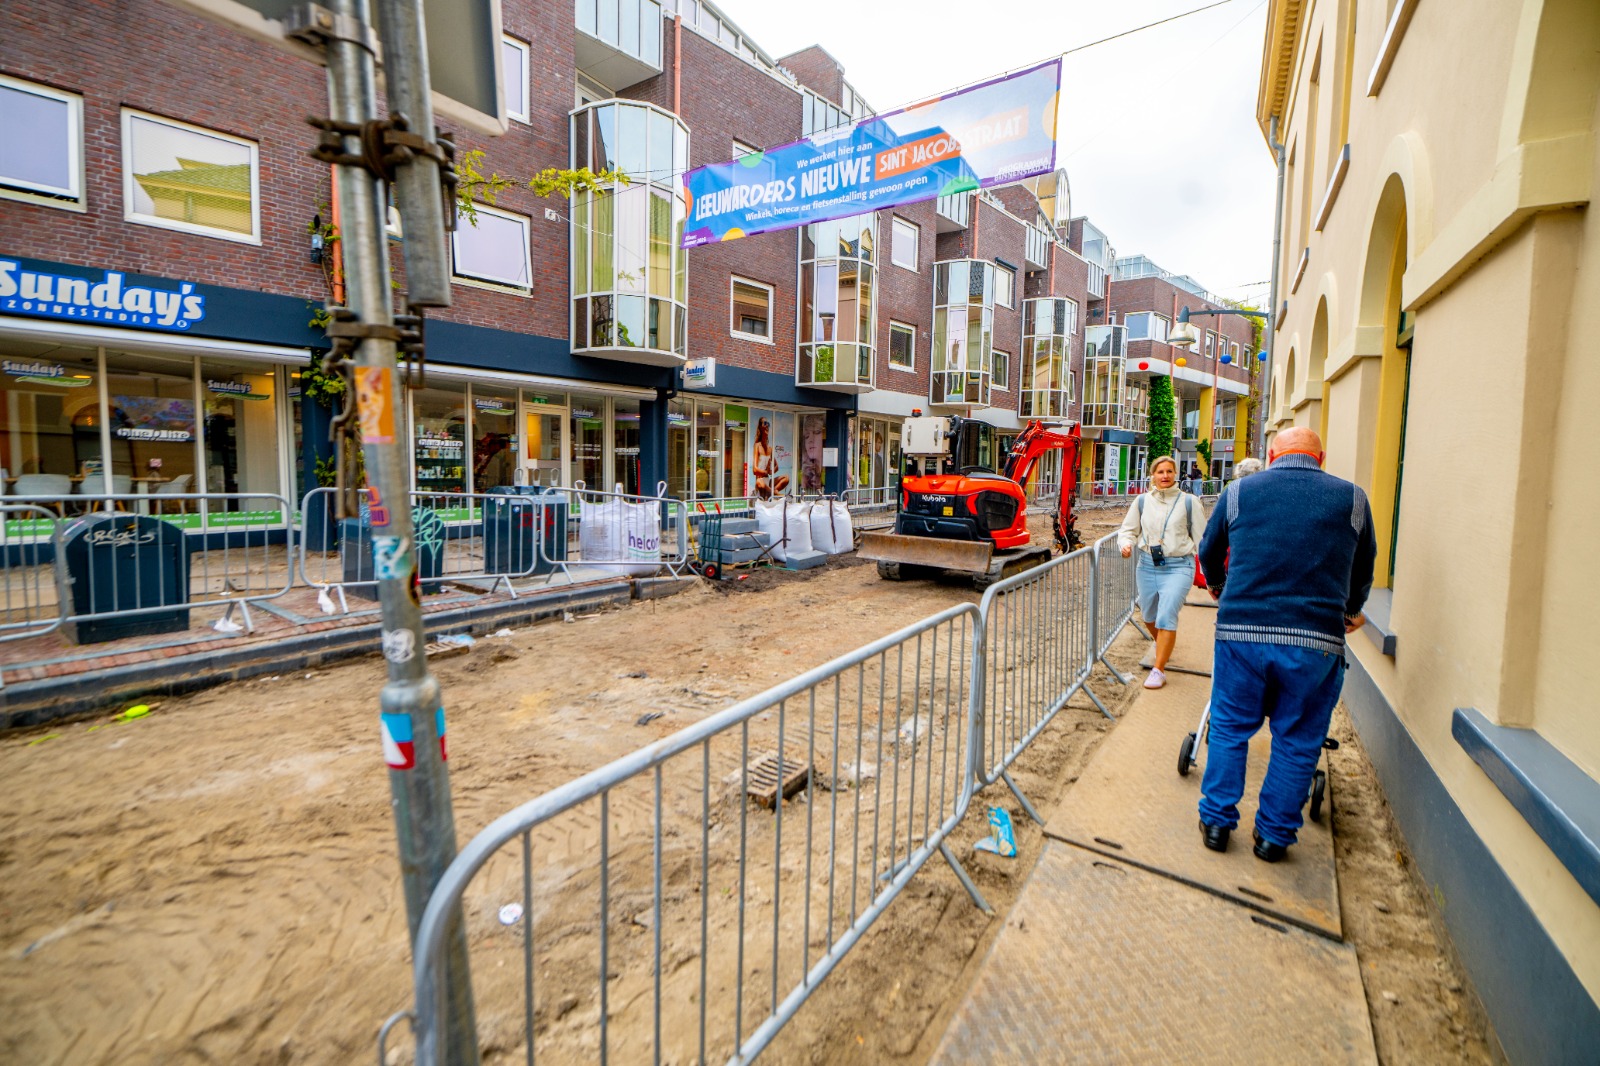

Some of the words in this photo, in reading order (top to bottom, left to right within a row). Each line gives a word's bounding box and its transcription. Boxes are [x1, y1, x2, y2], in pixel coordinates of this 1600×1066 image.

[797, 159, 809, 169] We
[809, 151, 837, 165] werken
[838, 144, 855, 158] hier
[856, 142, 873, 153] aan
[695, 175, 796, 221] LEEUWARDERS
[801, 155, 872, 198] NIEUWE
[879, 149, 908, 173] SINT
[745, 208, 773, 222] Winkels,
[774, 203, 800, 219] horeca
[801, 202, 811, 211] en
[812, 190, 867, 210] fietsenstalling
[869, 181, 903, 200] gewoon
[904, 175, 928, 192] open
[0, 260, 203, 327] Sunday's
[7, 299, 151, 325] ZONNESTUDIO
[2, 360, 65, 377] Sunday's
[207, 379, 252, 394] Sunday's
[921, 494, 947, 503] Kubota
